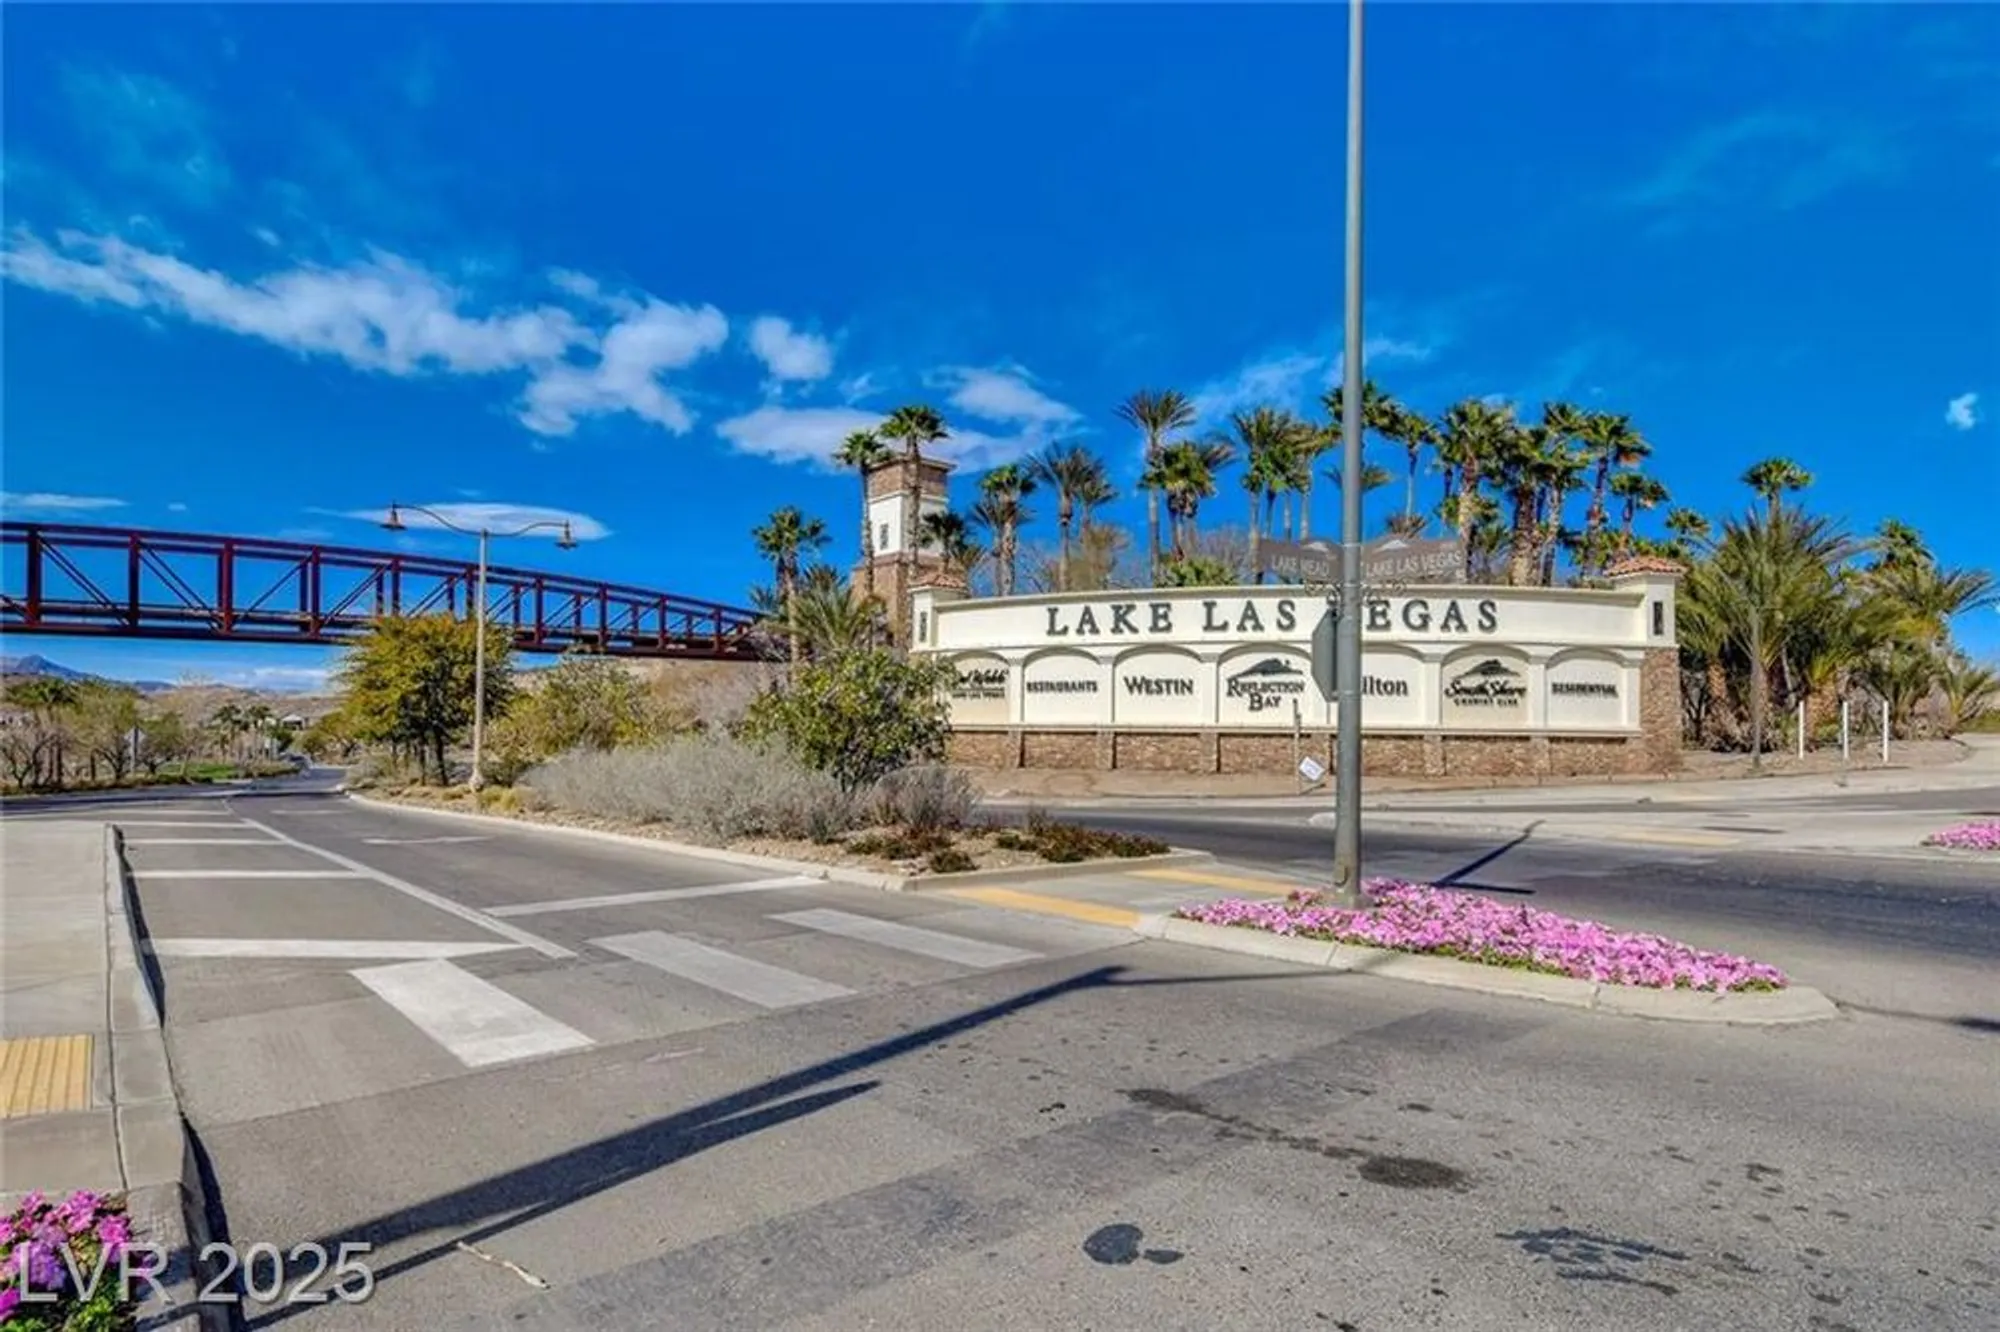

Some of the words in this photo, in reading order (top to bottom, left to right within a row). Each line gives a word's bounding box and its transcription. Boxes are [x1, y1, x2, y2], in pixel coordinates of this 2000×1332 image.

[1046, 602, 1174, 637] LAKE
[1202, 600, 1297, 634] LAS
[1361, 599, 1498, 634] EGAS
